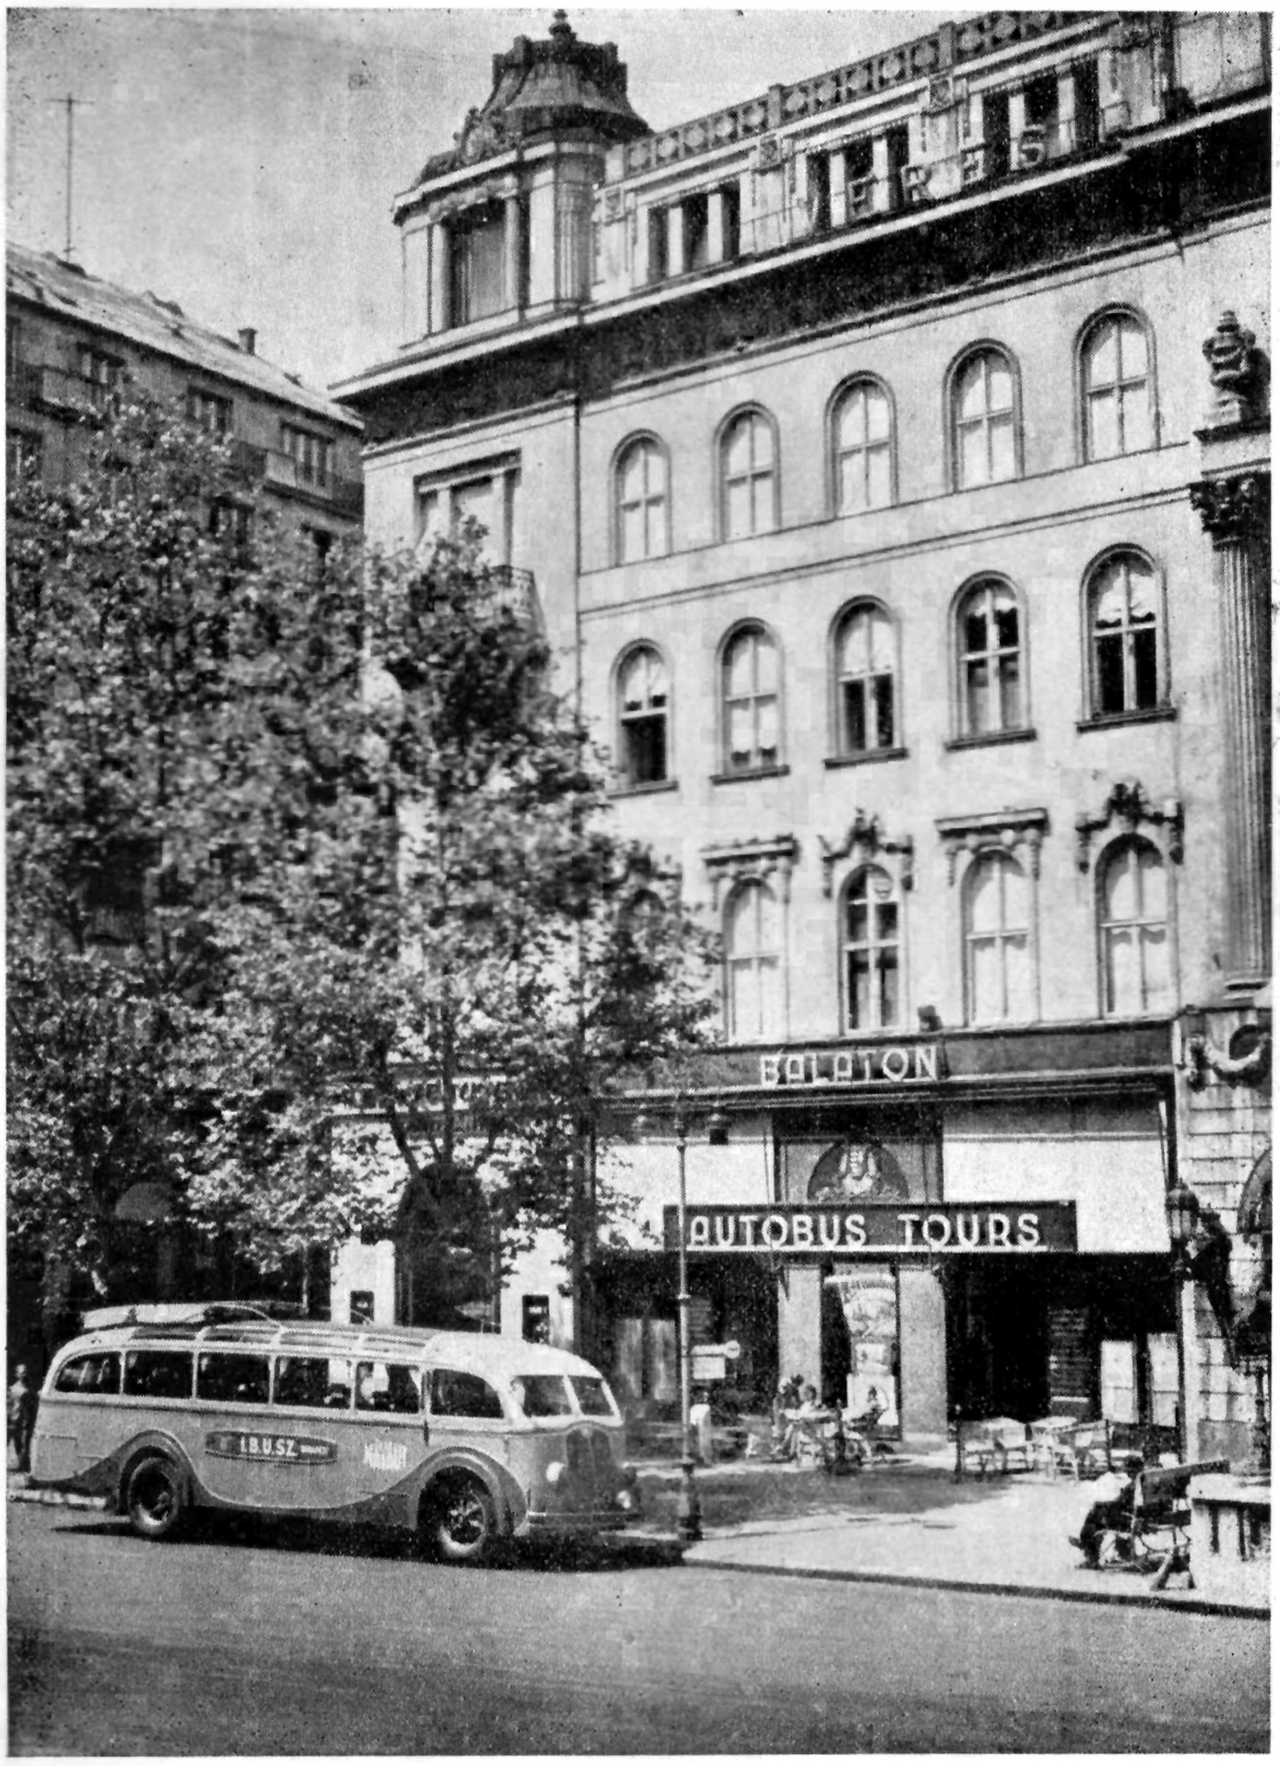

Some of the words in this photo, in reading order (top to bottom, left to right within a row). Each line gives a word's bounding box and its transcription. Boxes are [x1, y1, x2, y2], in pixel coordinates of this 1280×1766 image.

[760, 1046, 938, 1086] BALATON
[690, 1214, 866, 1247] AUTOBUS
[897, 1213, 1040, 1247] TOURS
